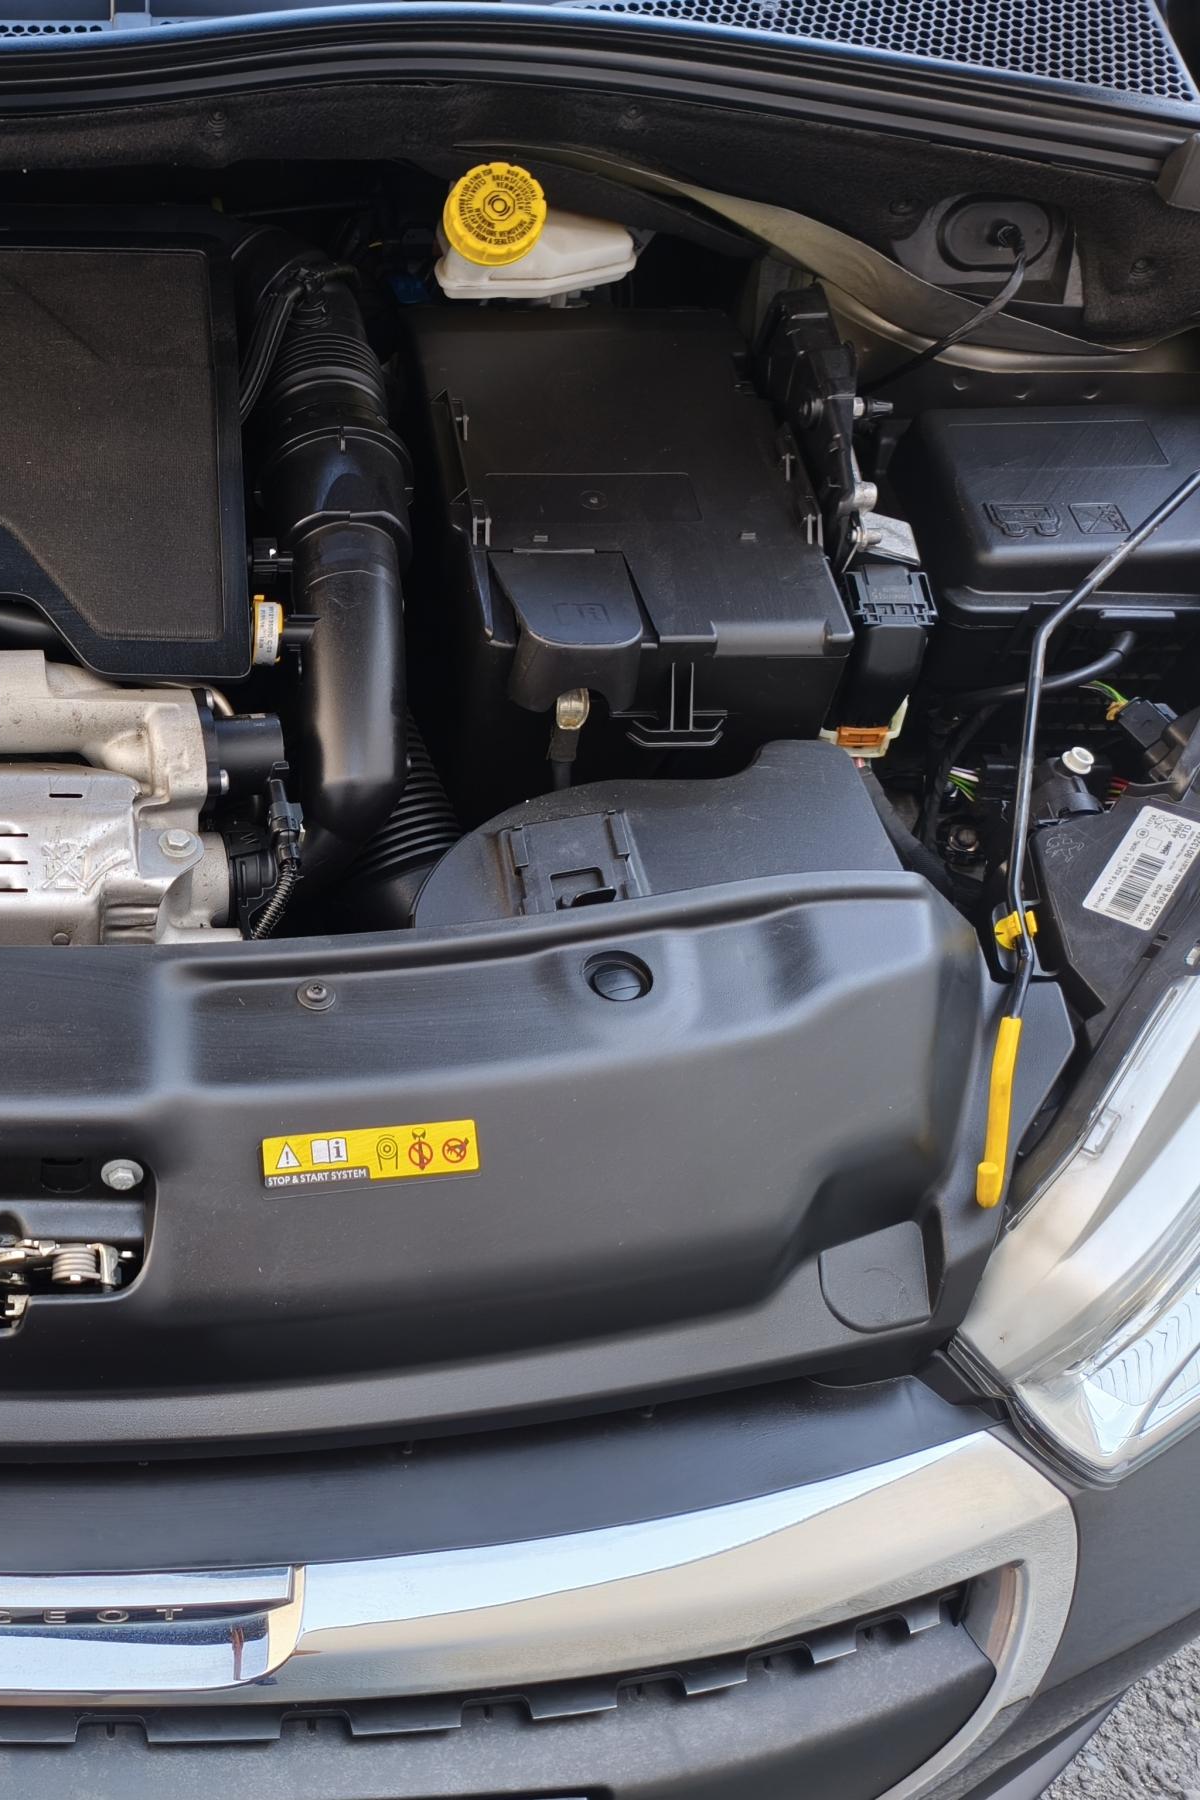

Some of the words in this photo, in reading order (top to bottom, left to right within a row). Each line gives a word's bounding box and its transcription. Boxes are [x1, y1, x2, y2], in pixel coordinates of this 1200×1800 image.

[268, 1175, 290, 1186] STOP
[292, 1175, 299, 1184] &
[300, 1172, 329, 1183] START
[331, 1168, 367, 1180] SYSTEM
